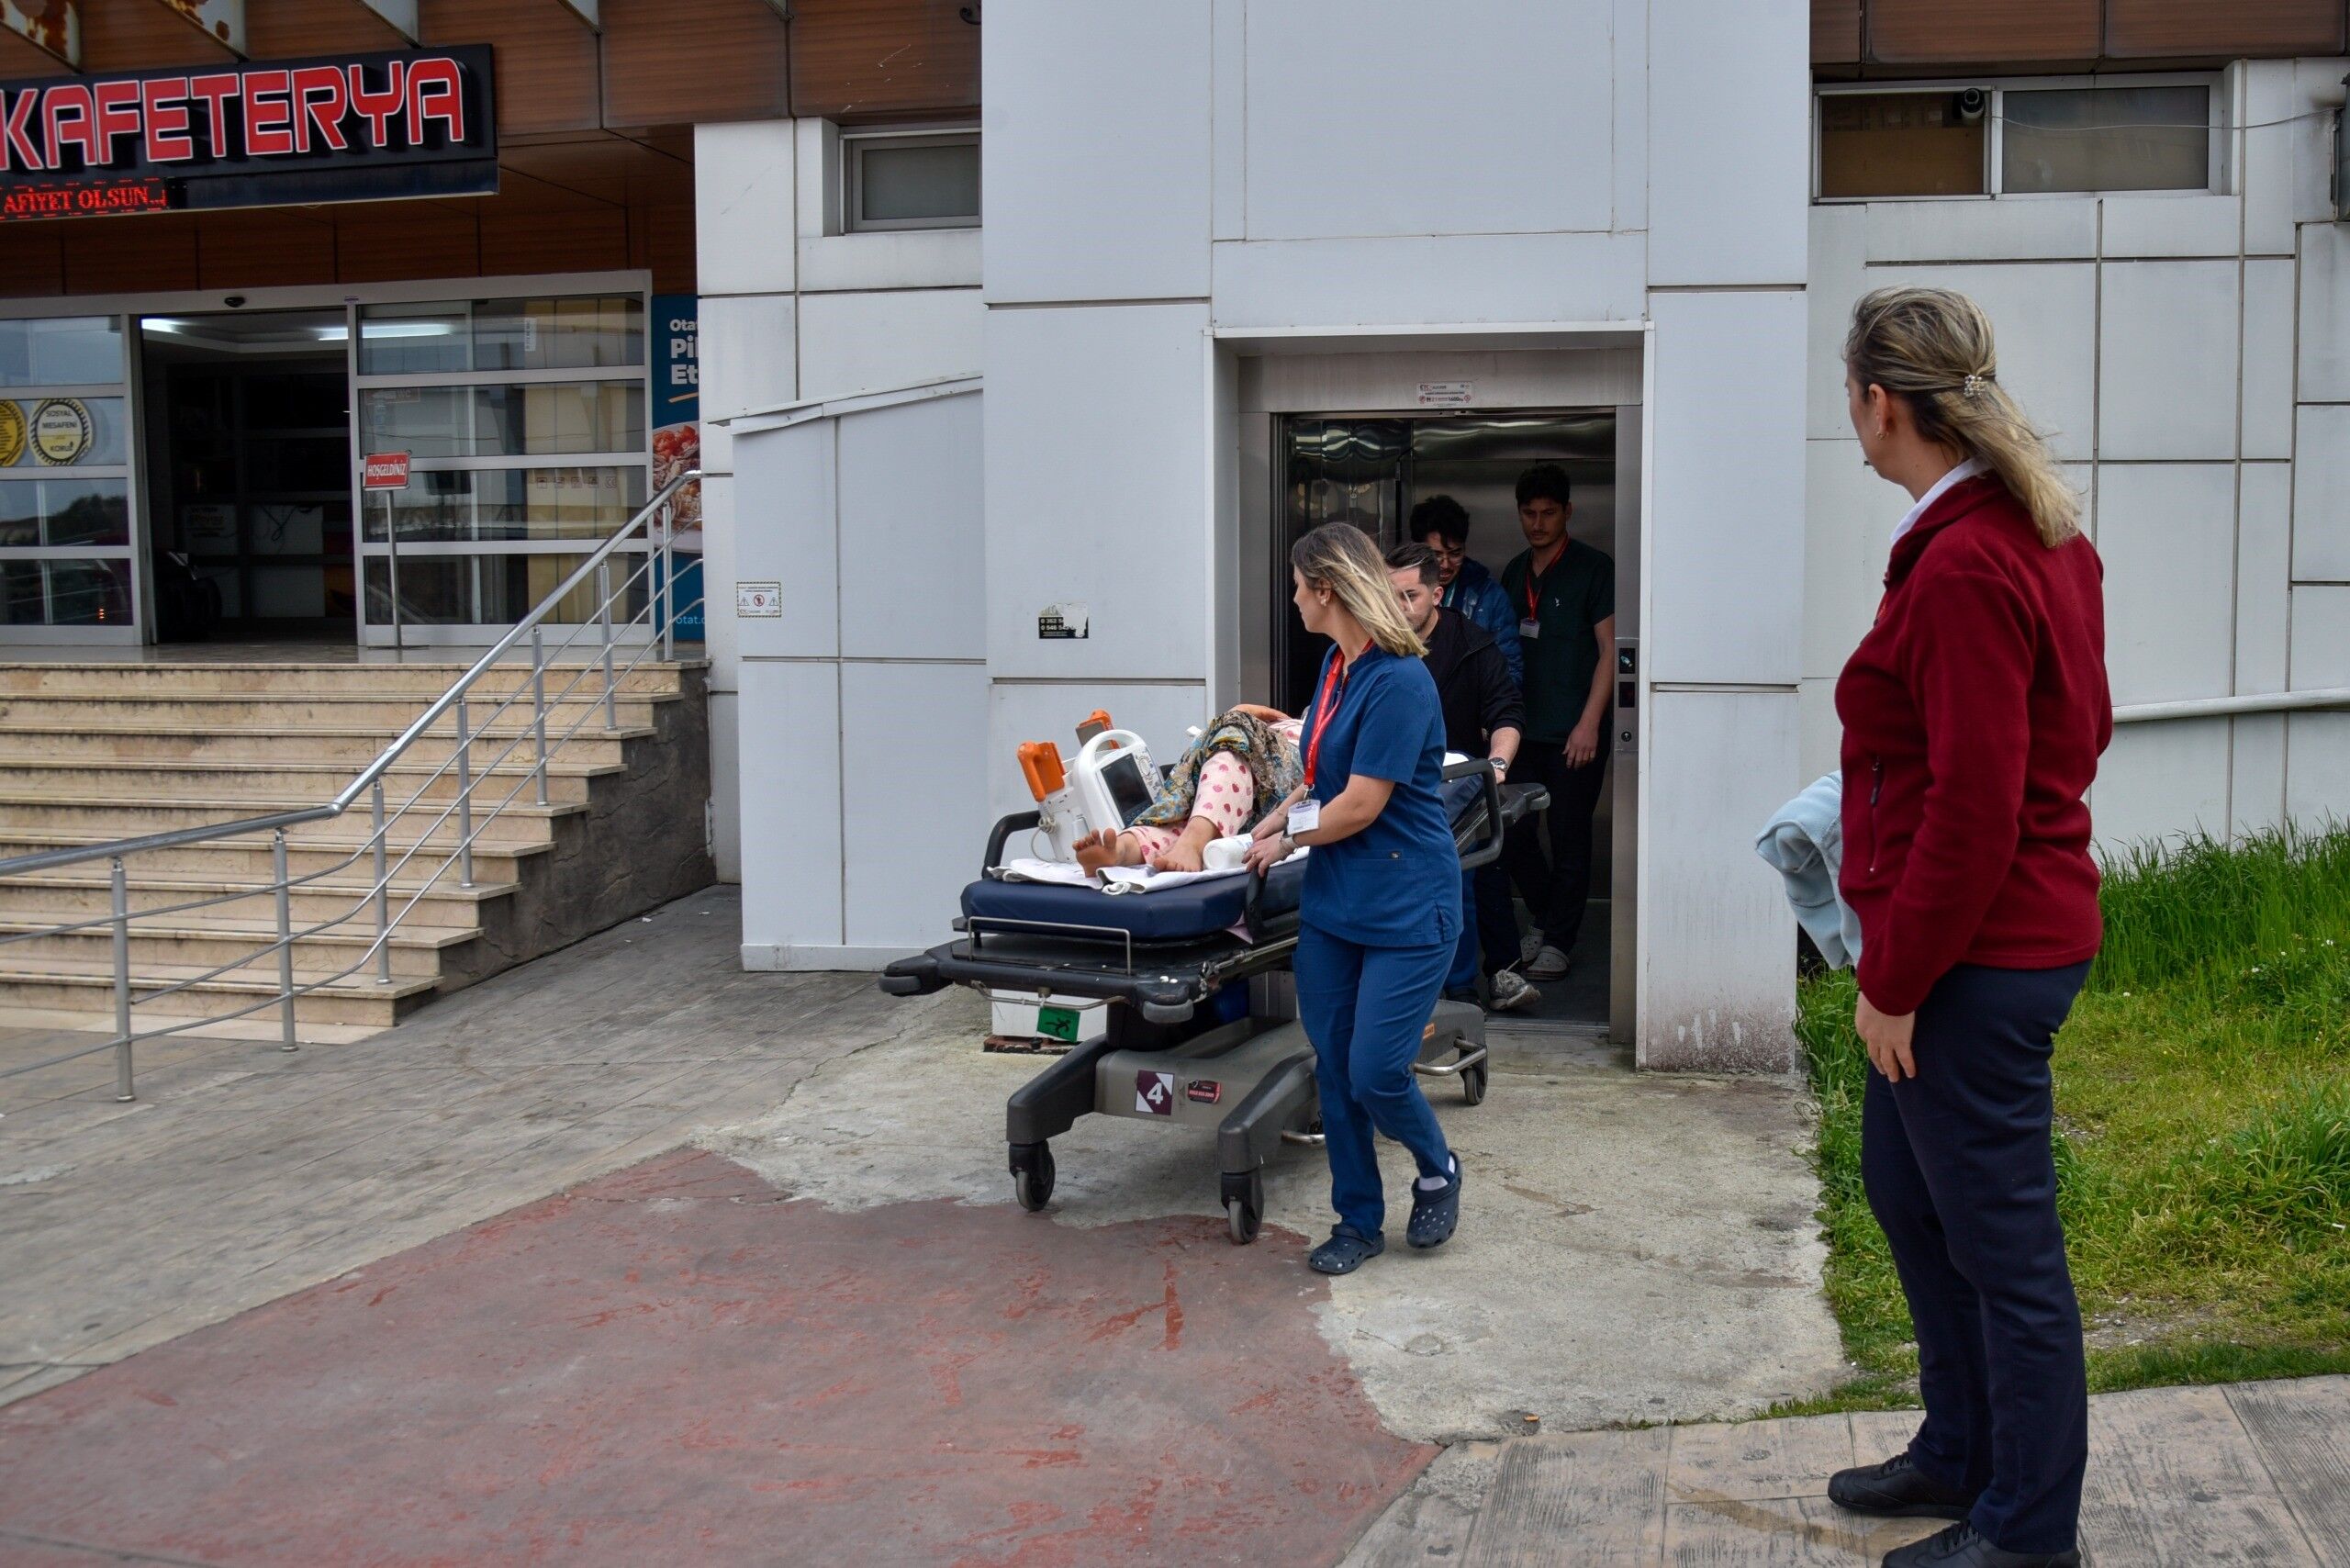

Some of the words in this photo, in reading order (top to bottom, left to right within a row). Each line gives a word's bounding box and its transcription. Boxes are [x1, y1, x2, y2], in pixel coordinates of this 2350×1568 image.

[0, 58, 464, 171] KAFETERYA
[4, 186, 73, 214] AFİYET
[1147, 1081, 1163, 1104] 4
